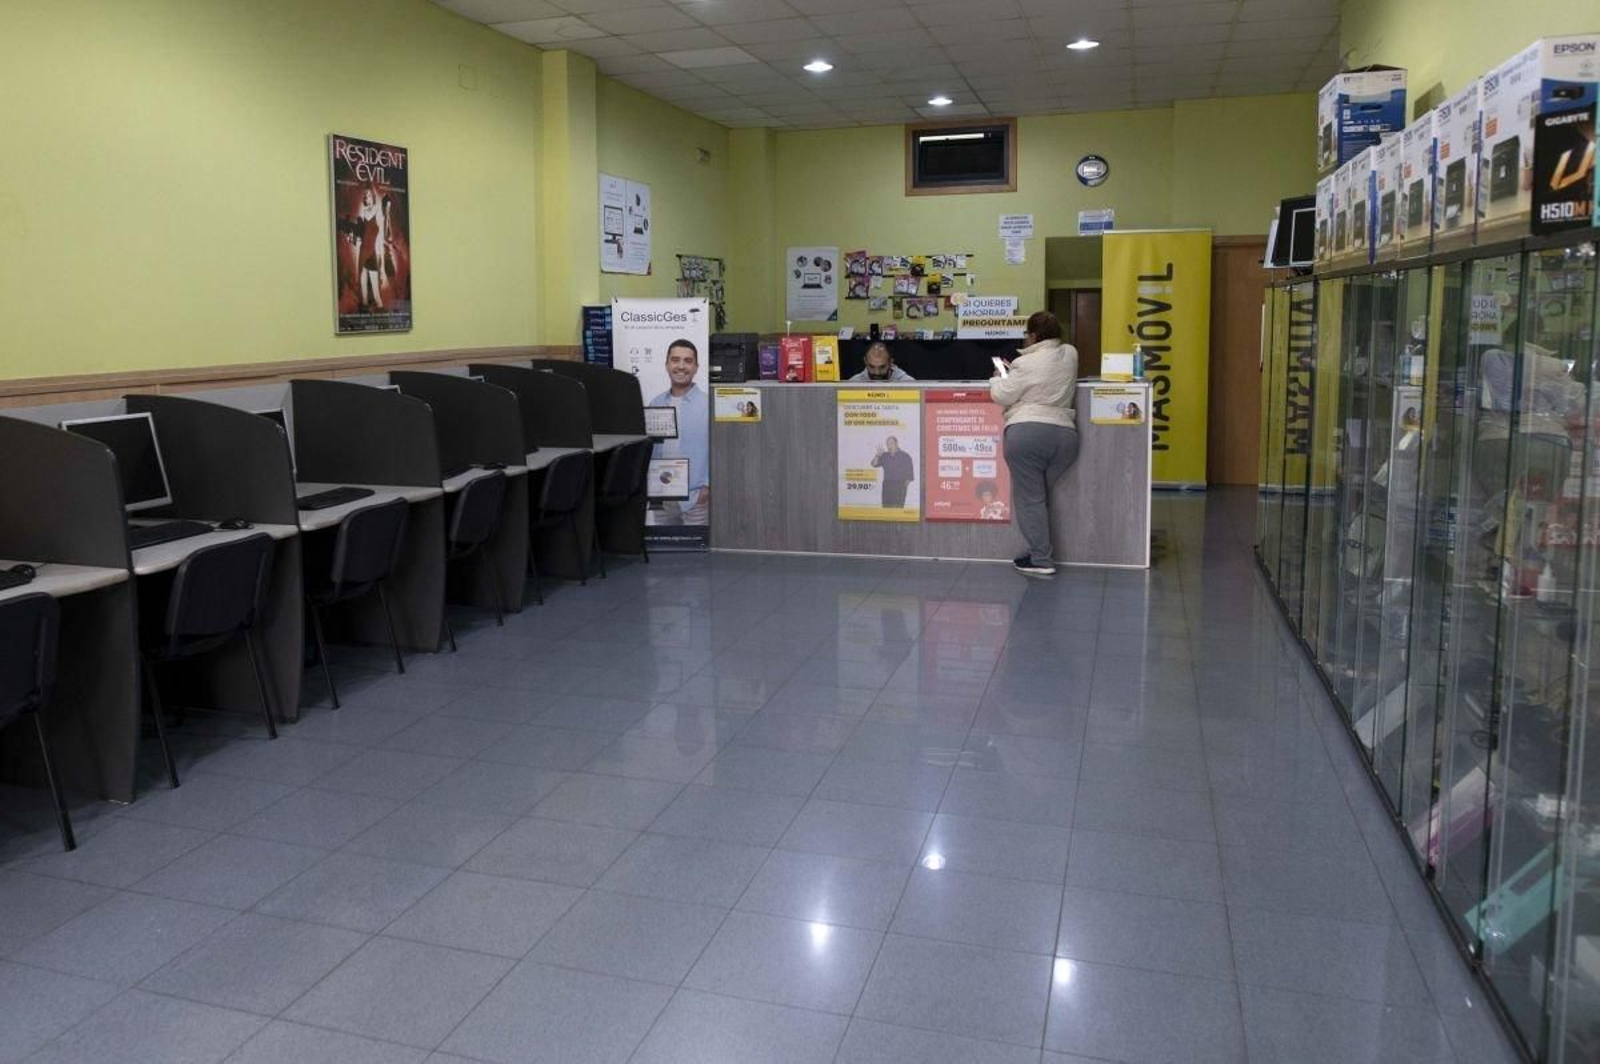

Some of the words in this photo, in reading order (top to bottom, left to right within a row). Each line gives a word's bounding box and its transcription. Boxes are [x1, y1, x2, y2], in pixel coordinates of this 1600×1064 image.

[1554, 42, 1596, 54] EPSON
[1544, 112, 1590, 127] GIGABYTE
[335, 139, 406, 175] RESIDENT
[356, 161, 390, 185] EVIL
[972, 298, 1012, 308] QUIERES
[620, 311, 687, 322] ClassicGes
[962, 309, 1009, 317] AHORRAR,
